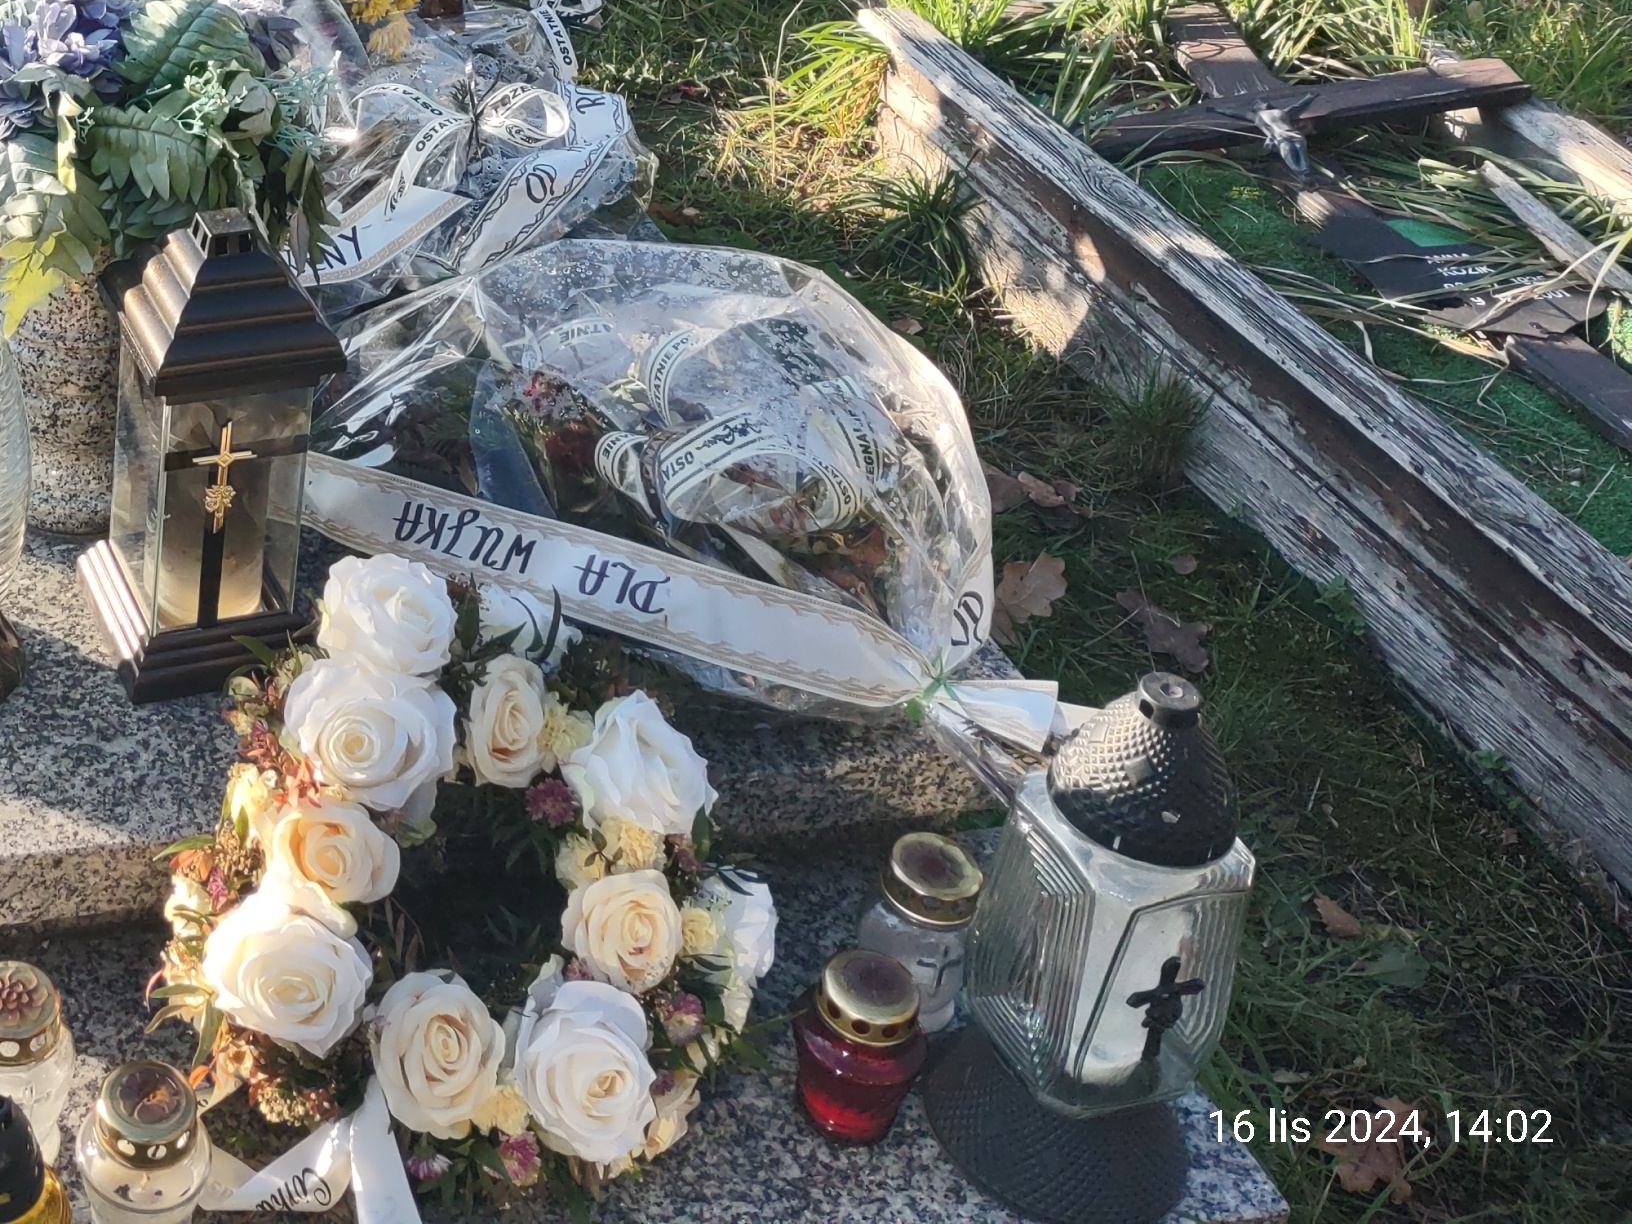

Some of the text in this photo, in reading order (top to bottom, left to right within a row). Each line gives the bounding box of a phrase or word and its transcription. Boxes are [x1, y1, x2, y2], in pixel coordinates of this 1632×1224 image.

[539, 9, 573, 66] OSTATNIE
[1437, 264, 1495, 277] KOZIK
[391, 500, 672, 615] DLA WUJKA
